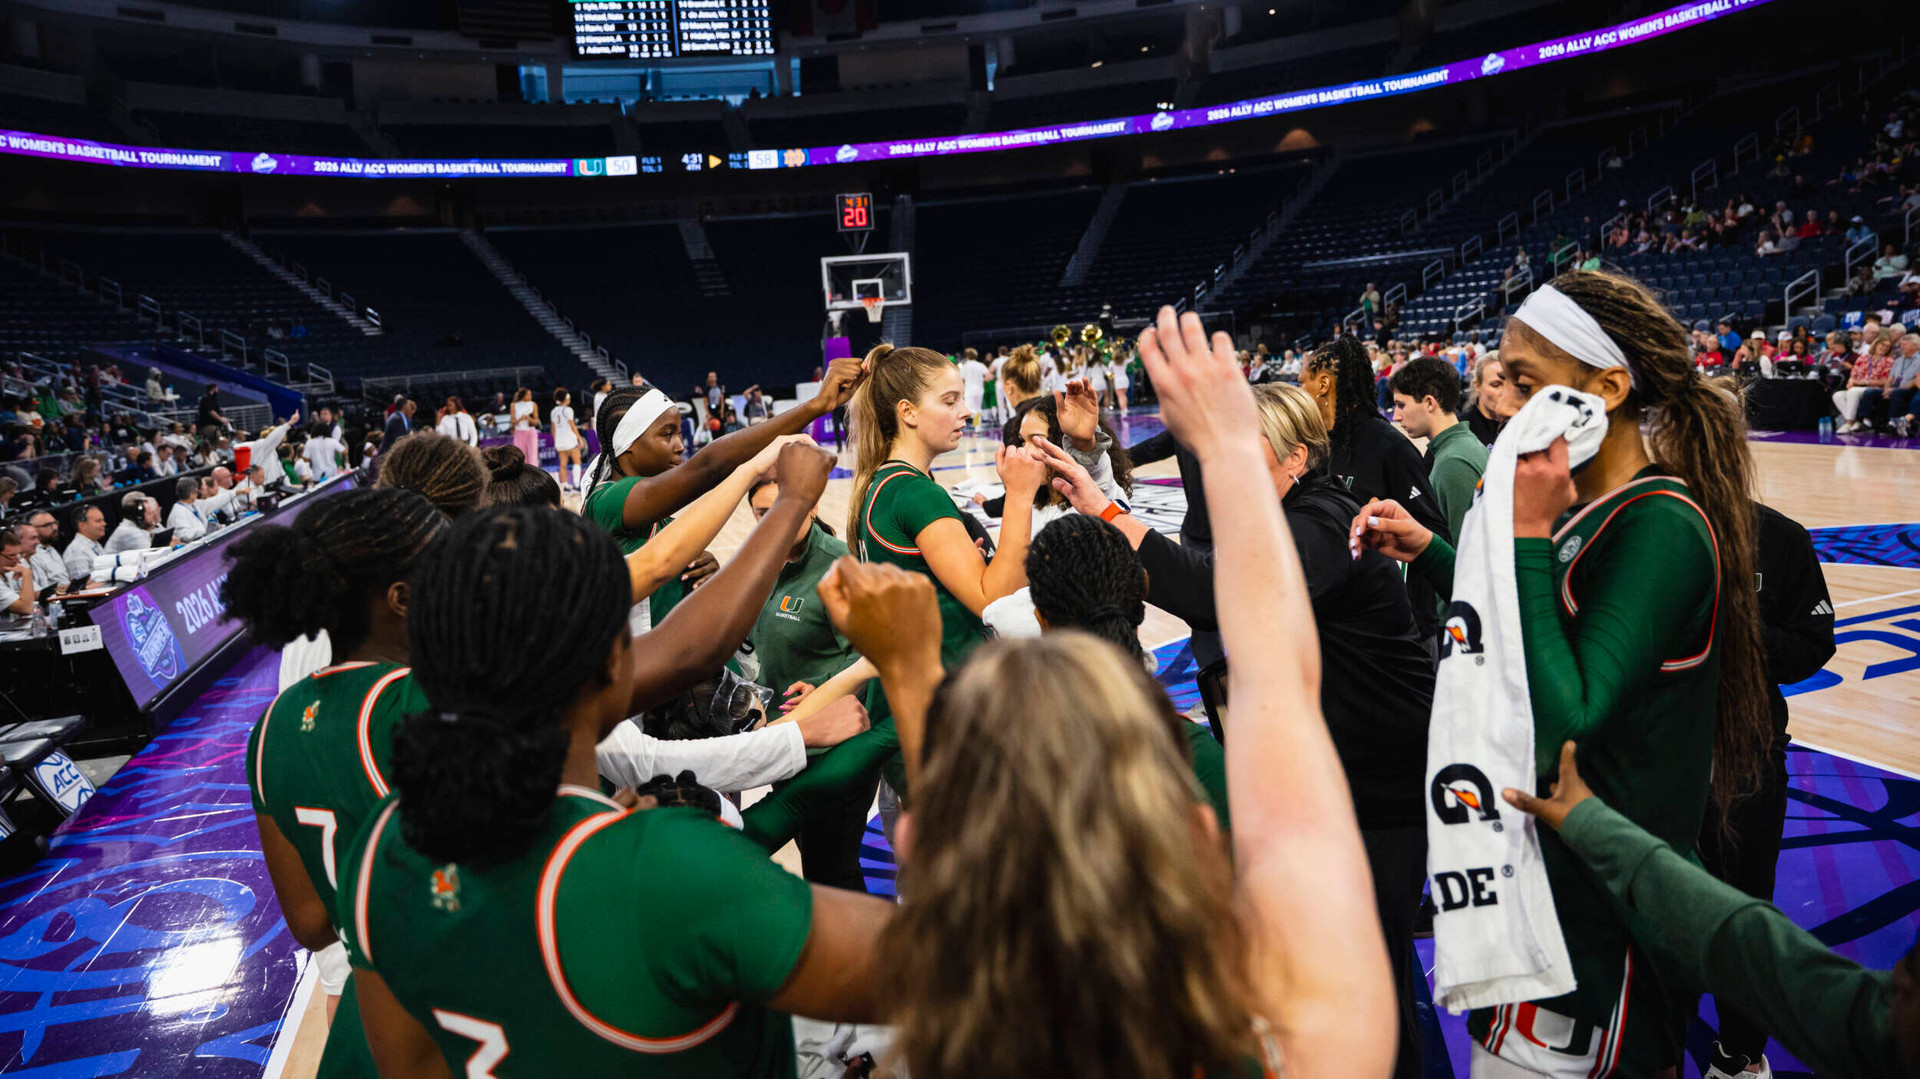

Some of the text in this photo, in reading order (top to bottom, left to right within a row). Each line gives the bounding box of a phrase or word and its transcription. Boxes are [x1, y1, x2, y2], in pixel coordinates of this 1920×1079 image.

[1538, 0, 1732, 58] 2026 ALLY ACC WOMEN'S BASKETBALL
[1207, 70, 1450, 121] 2026 ALLY ACC WOMEN'S BASKETBALL TOURNAMENT
[8, 136, 66, 154] WOMEN'S
[67, 143, 138, 163] BASKETBALL
[139, 152, 222, 167] TOURNAMENT
[889, 120, 1126, 155] 2026 ALLY ACC WOMEN'S BASKETBALL TOURNAMENT
[314, 161, 568, 174] 2026 ALLY ACC WOMEN'S BASKETBALL TOURNAMENT
[613, 160, 630, 172] 50
[682, 153, 702, 164] 4:31
[756, 153, 772, 166] 58
[843, 207, 868, 227] 20
[176, 588, 214, 634] 2026
[776, 612, 800, 621] BASKETBALL
[53, 762, 80, 794] ACC
[294, 806, 338, 892] 7
